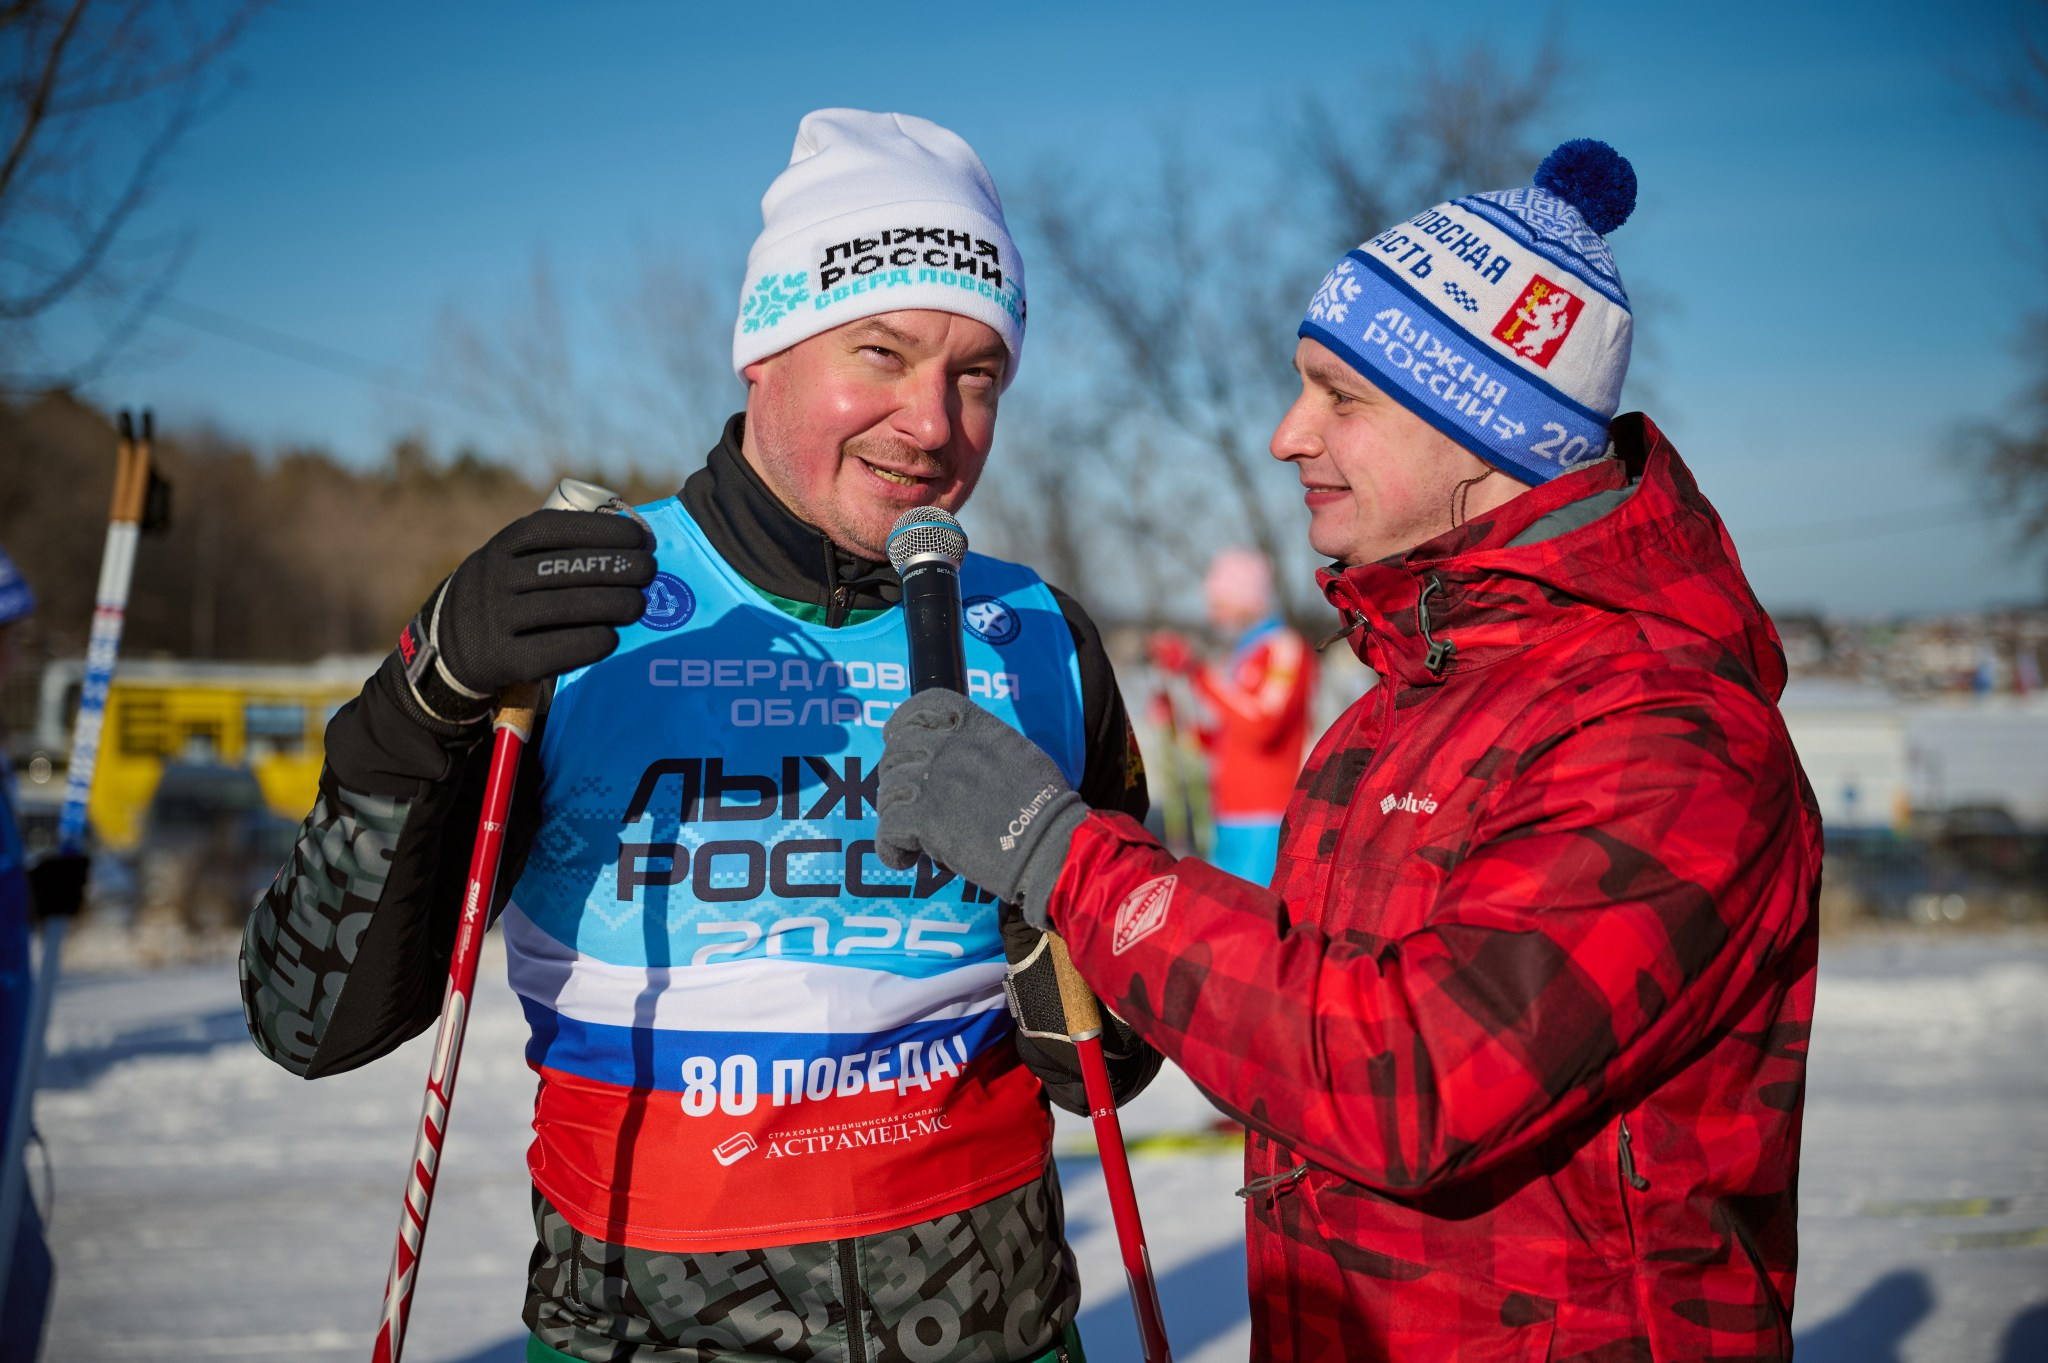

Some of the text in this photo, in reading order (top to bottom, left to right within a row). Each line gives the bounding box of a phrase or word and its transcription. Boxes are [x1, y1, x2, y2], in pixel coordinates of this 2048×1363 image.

[819, 227, 1000, 268] ЛЫЖНЯ
[820, 247, 1002, 291] РОССИИ
[1369, 228, 1434, 280] АСТЬ
[1409, 208, 1513, 286] ОВСКАЯ
[1362, 321, 1496, 428] РОССИИ
[1374, 307, 1509, 407] ЛЫЖНЯ
[1530, 421, 1602, 467] 20
[537, 556, 612, 576] CRAFT
[648, 658, 1020, 701] СВЕРДЛОВАЯ
[731, 698, 899, 729] ОБЛАС
[621, 755, 881, 824] ЛЫЖ
[617, 838, 999, 904] РОССИ
[691, 916, 971, 967] 2025
[680, 1034, 969, 1118] 80 ПОБЕДА!
[764, 1114, 953, 1159] АСТРАМЕД-МС
[768, 1106, 946, 1140] СТРАХОВАЯ МЕДИЦИНСКАЯ КОМПАНИ
